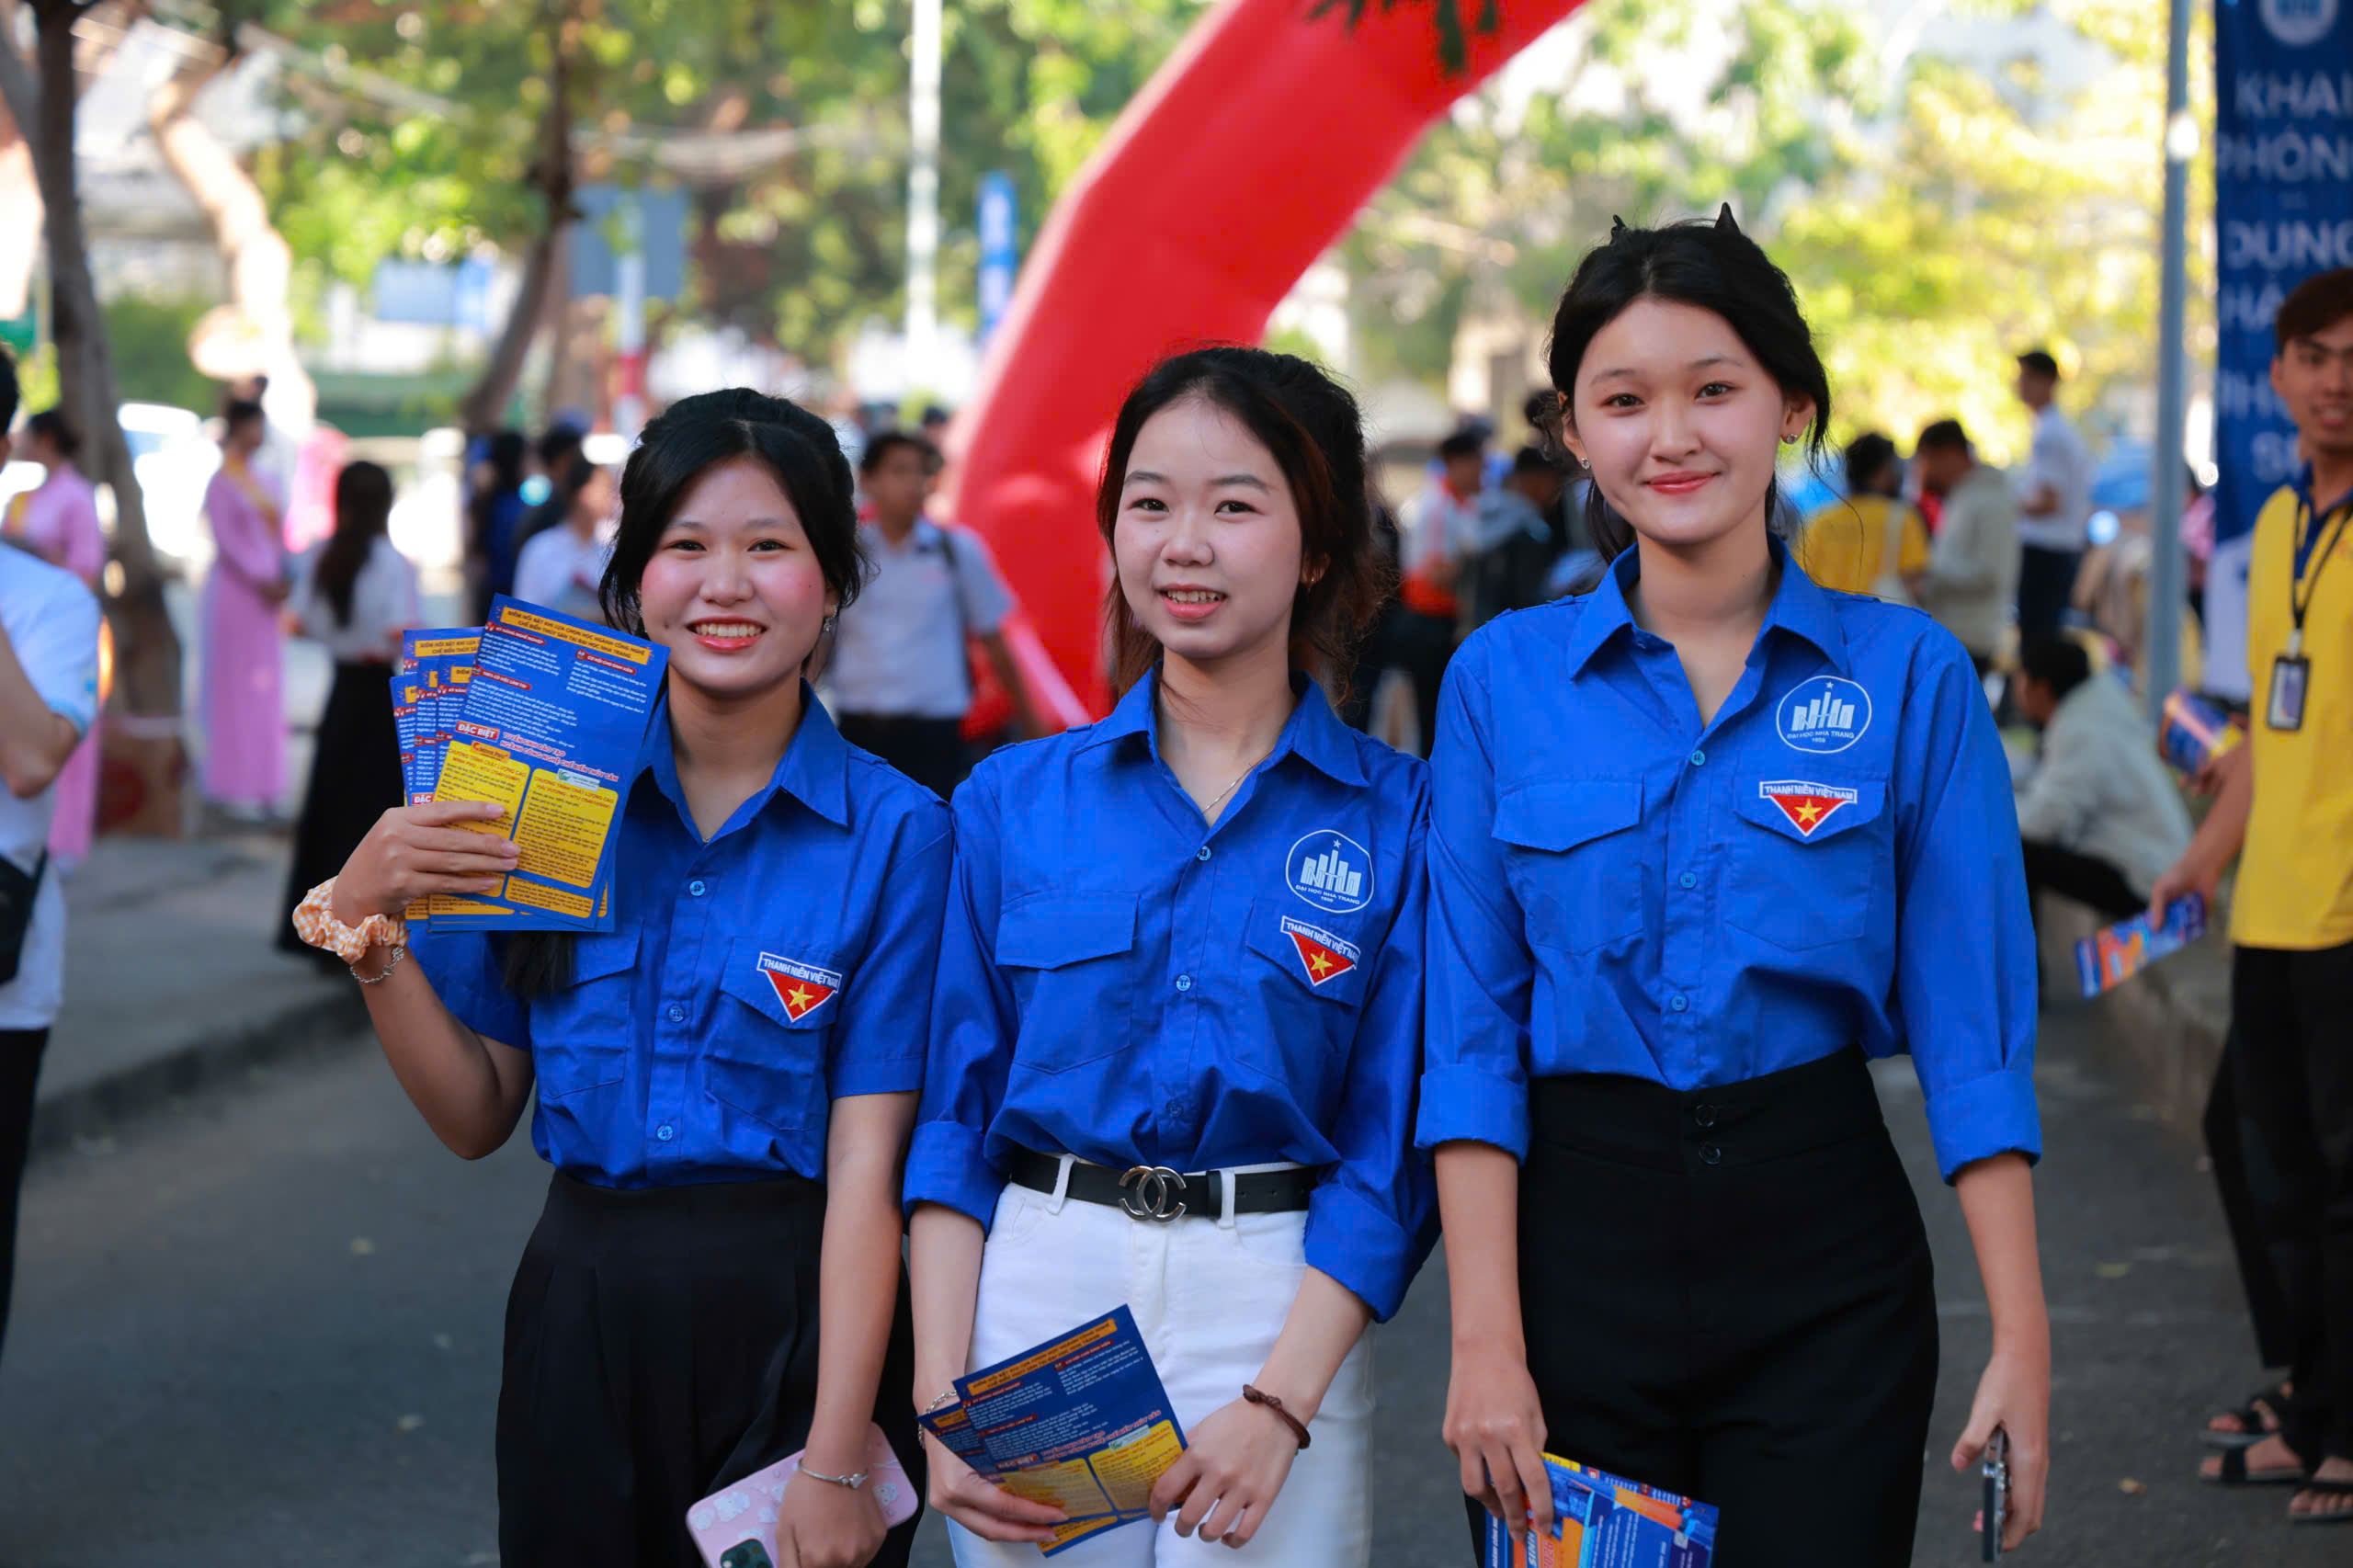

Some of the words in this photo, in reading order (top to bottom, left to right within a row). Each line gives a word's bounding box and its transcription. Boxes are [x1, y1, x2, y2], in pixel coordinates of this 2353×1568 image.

[458, 723, 477, 734] ĐẶC
[1831, 730, 1855, 739] TRANG
[1765, 786, 1794, 795] THANH
[1794, 784, 1814, 796] NIÊN
[1814, 787, 1835, 799] VIỆT
[1835, 791, 1854, 800] NAM
[1338, 894, 1360, 905] TRANG
[1287, 922, 1314, 938] THANH
[1313, 931, 1332, 948] NIÊN
[1332, 939, 1349, 955] VIỆT
[762, 958, 790, 973] THANH
[790, 966, 810, 980] NIÊN
[810, 971, 828, 984] VIỆT
